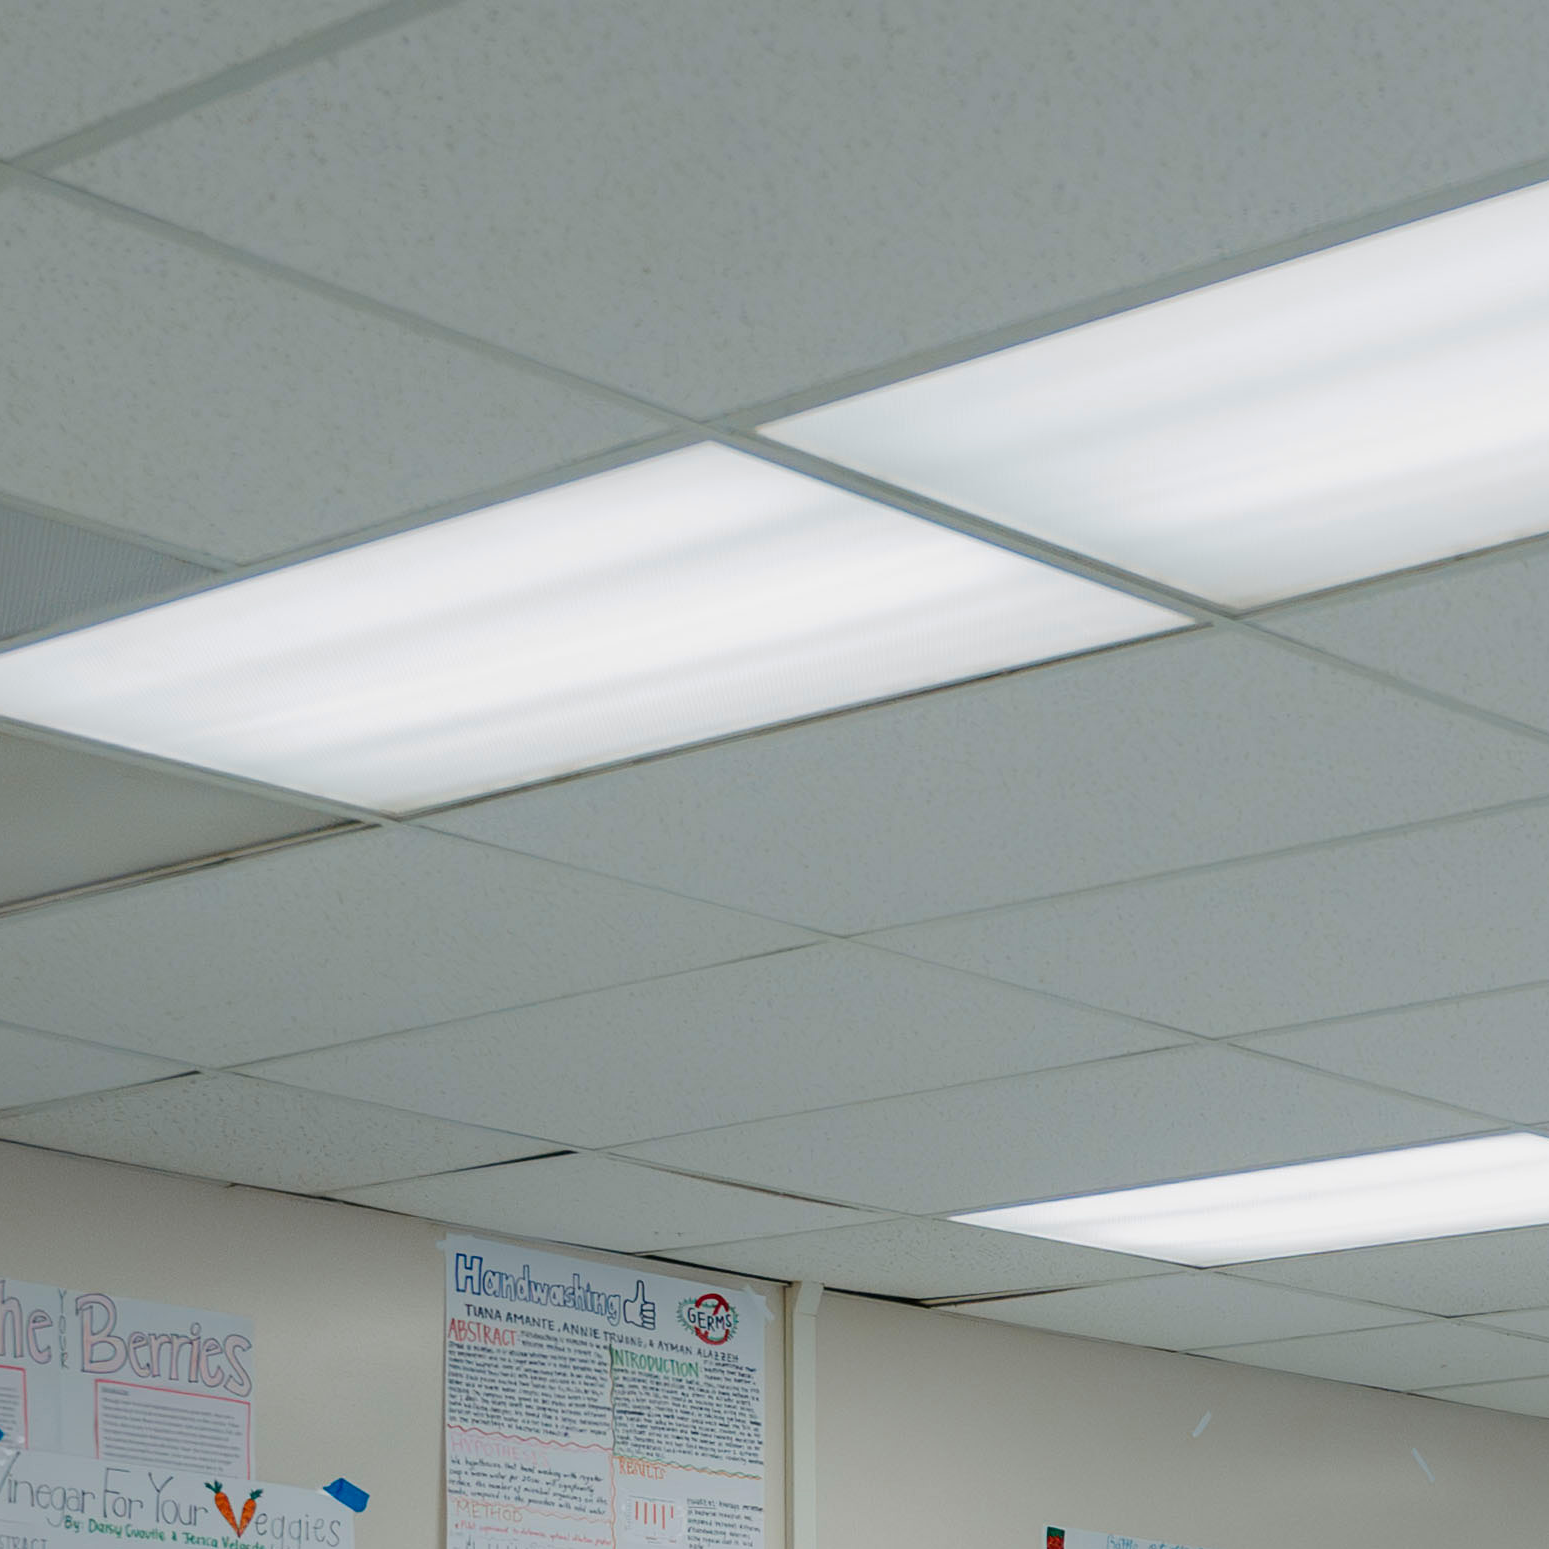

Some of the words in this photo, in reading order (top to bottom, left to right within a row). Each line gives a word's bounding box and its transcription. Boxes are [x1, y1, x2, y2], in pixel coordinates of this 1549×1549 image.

[455, 1252, 622, 1326] Handwashing
[75, 1292, 253, 1397] Berries
[464, 1303, 502, 1322] TIANA
[562, 1323, 601, 1340] ANNIE
[658, 1340, 693, 1355] AYMAN
[687, 1308, 732, 1332] GERMS
[103, 1467, 145, 1520] For
[148, 1472, 209, 1528] Your
[88, 1519, 122, 1539] Daisy
